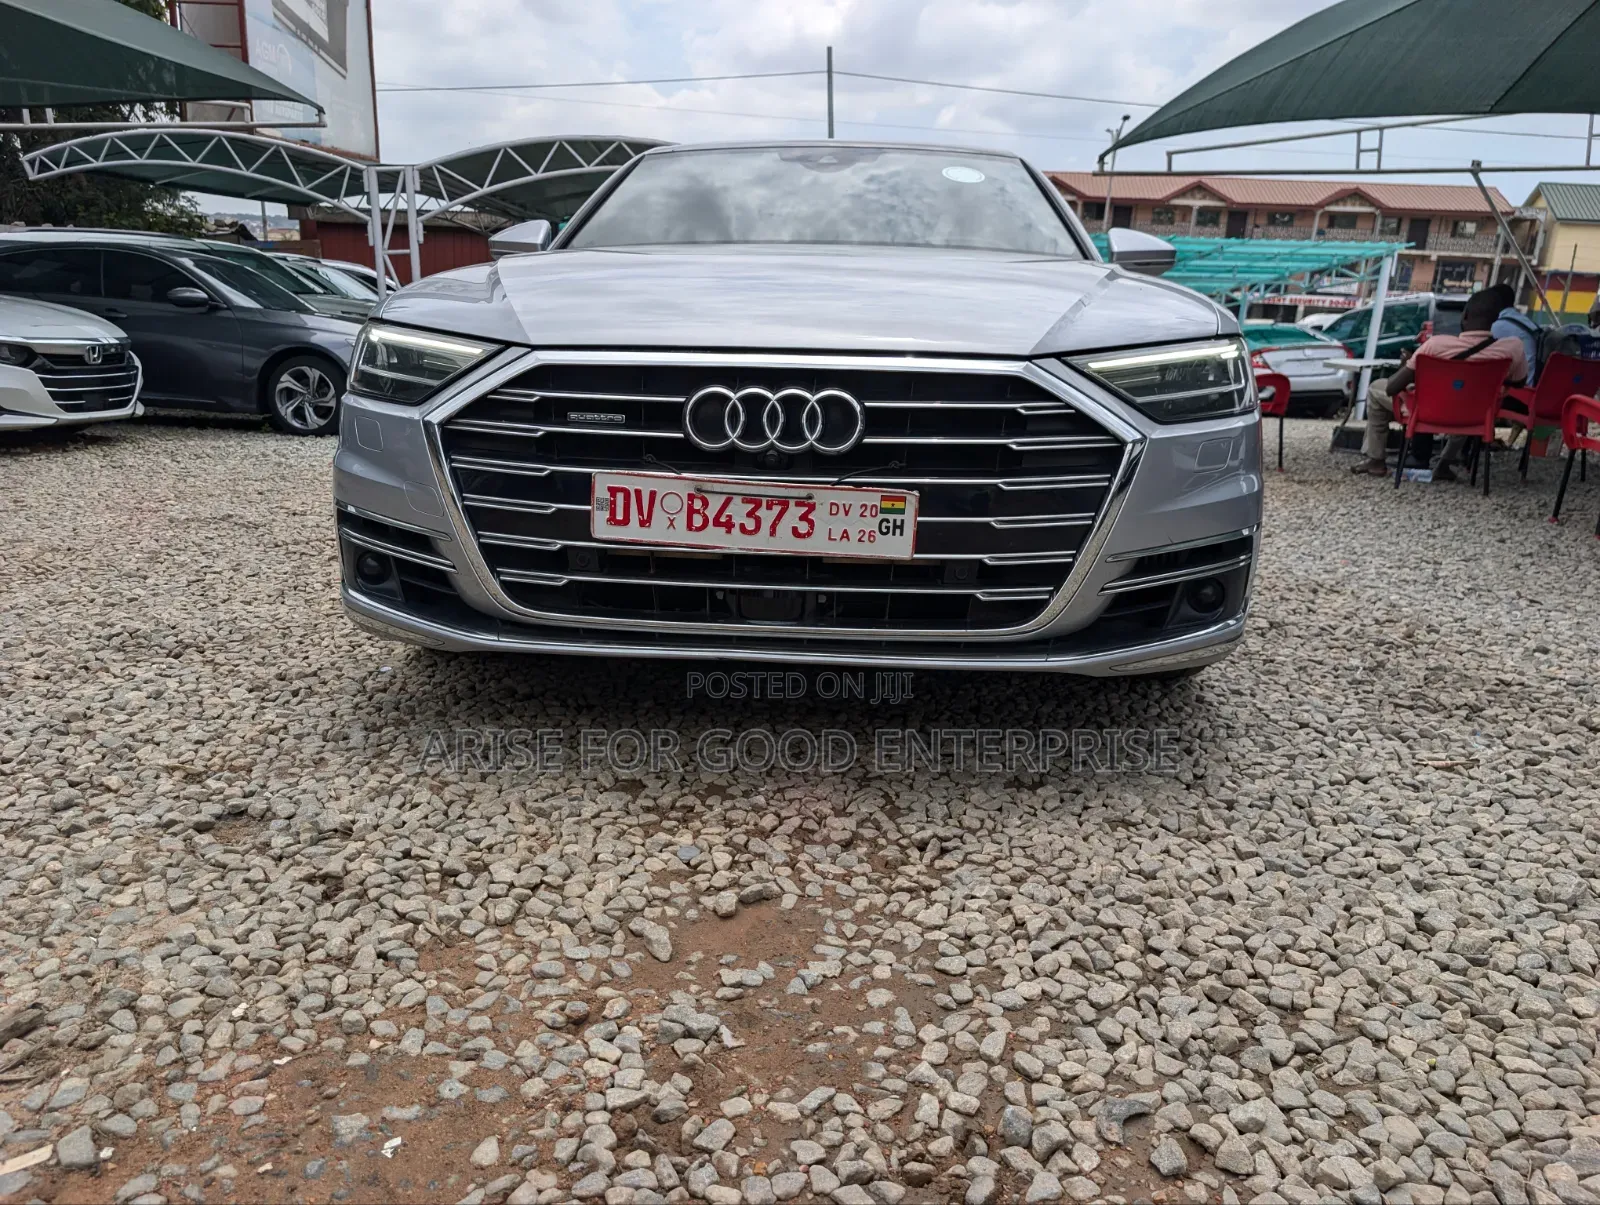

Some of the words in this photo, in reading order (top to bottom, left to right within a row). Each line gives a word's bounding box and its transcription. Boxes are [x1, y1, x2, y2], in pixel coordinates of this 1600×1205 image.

[1289, 297, 1326, 306] SECURITY
[606, 485, 657, 528] DV
[686, 492, 817, 539] B4373
[829, 501, 852, 517] DV
[859, 503, 878, 518] 20
[828, 527, 850, 542] LA
[857, 529, 876, 543] 26
[878, 517, 905, 537] GH
